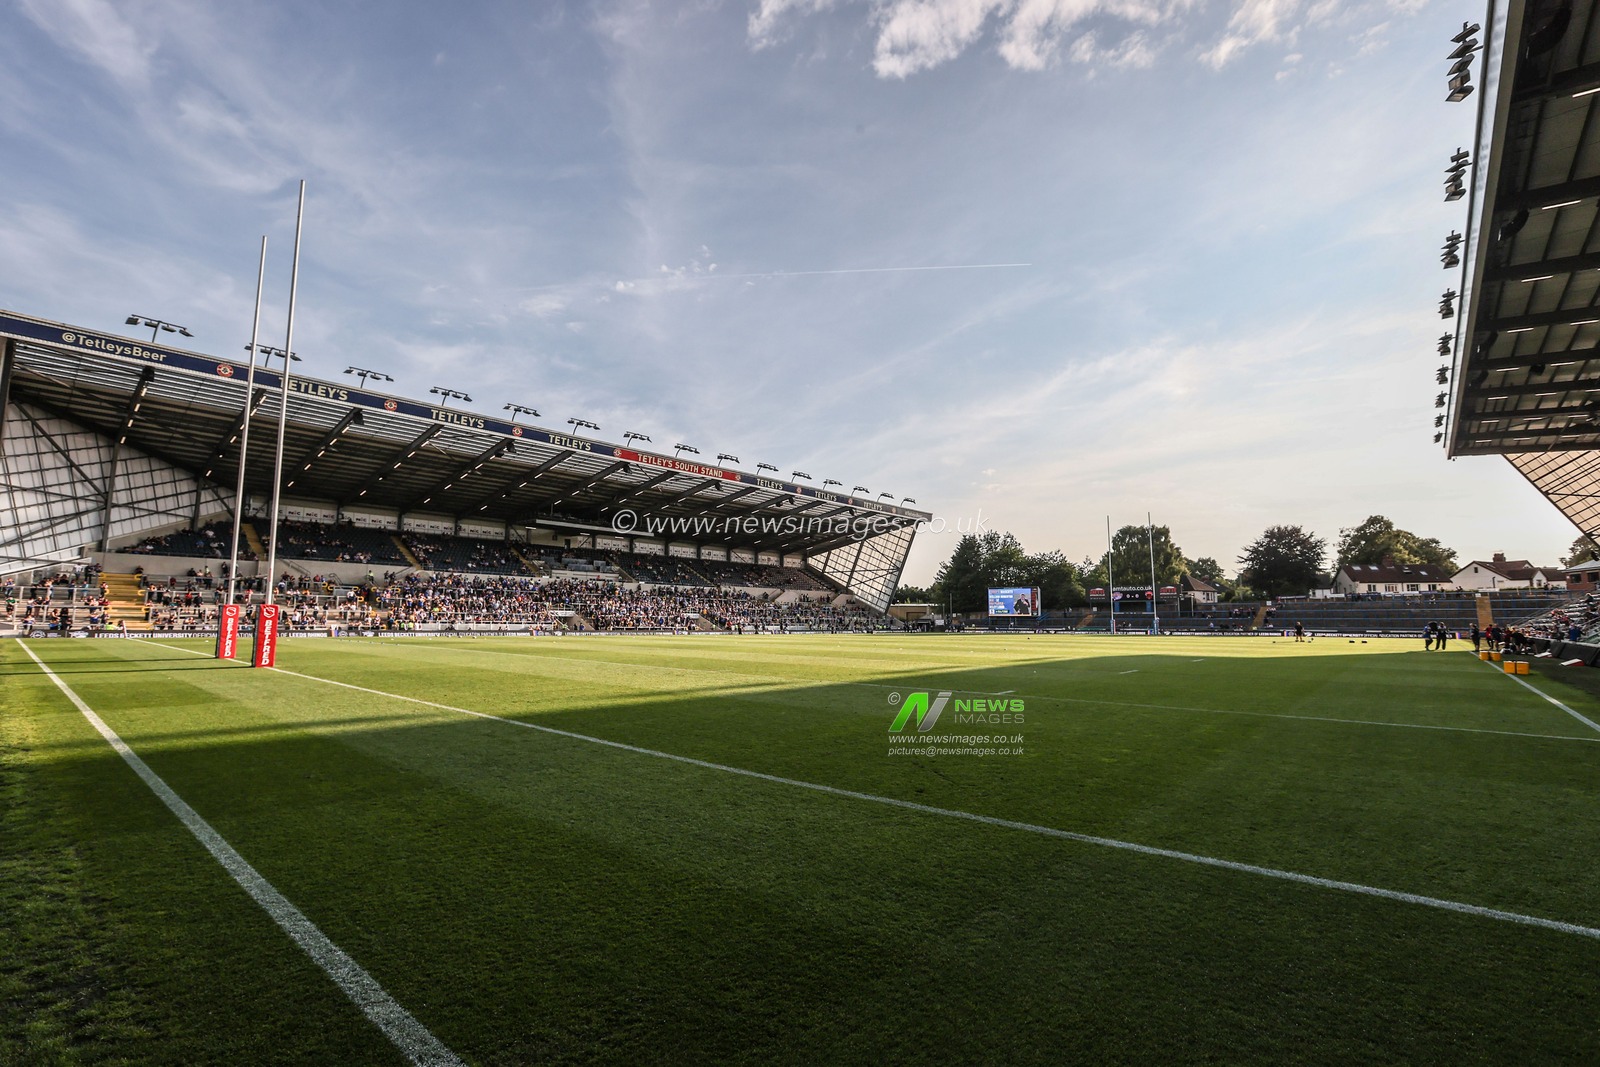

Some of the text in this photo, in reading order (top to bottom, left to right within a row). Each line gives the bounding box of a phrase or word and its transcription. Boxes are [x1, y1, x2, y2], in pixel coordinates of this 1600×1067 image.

[61, 331, 167, 363] @TetleysBeer
[431, 409, 485, 429] TETLEY'S
[549, 434, 592, 451] TETLEY'S
[637, 454, 723, 478] TETLEY'S SOUTH STAND
[757, 478, 783, 490] TETLEY'S
[224, 618, 233, 656] BETFRED
[261, 620, 272, 665] BETFRED
